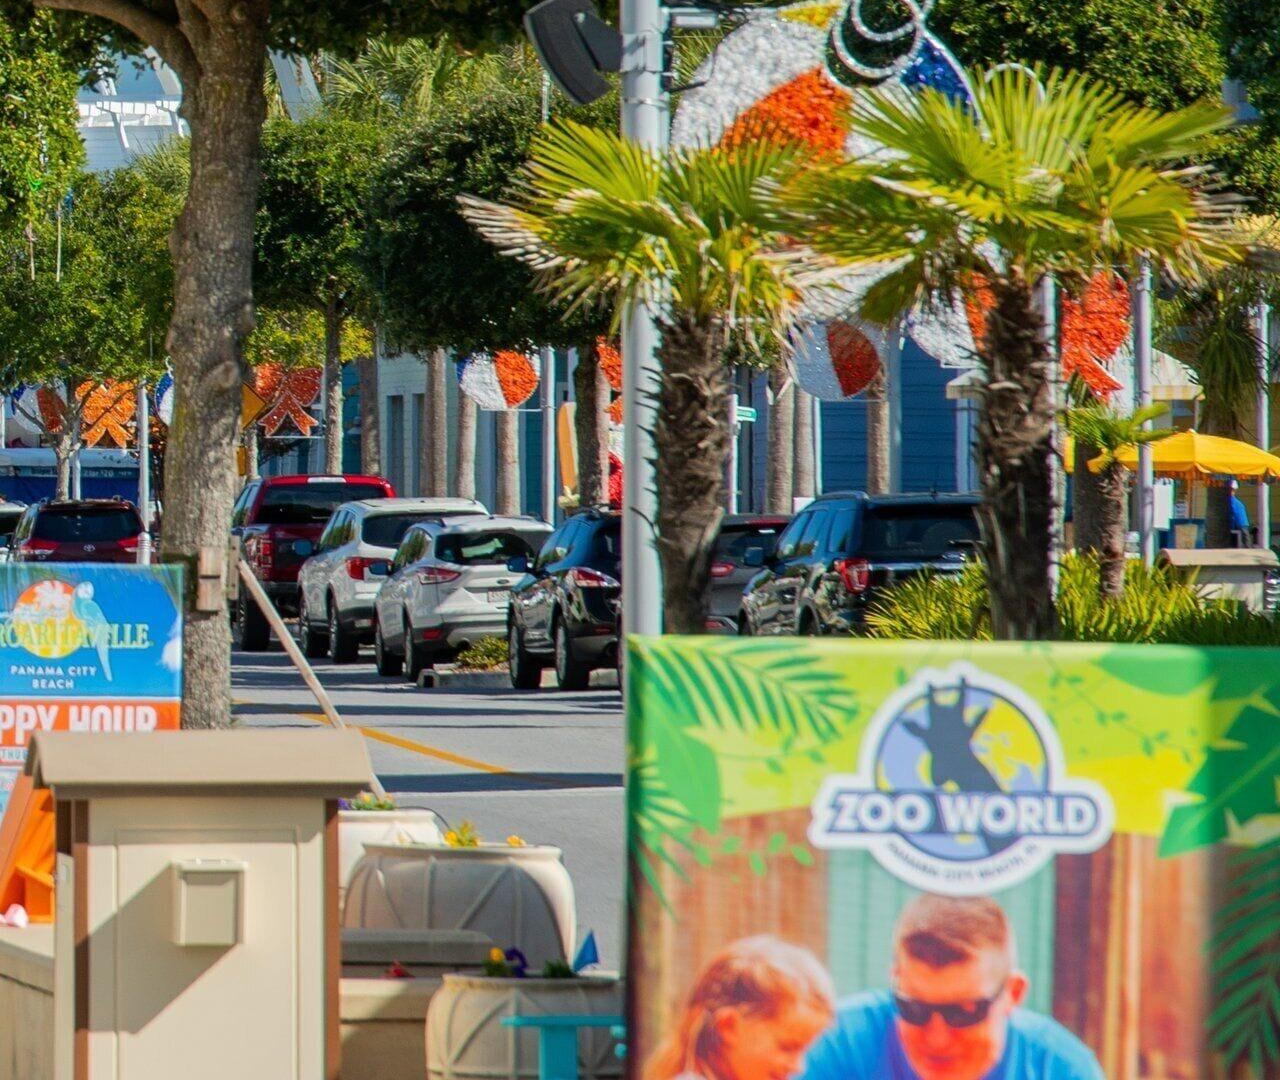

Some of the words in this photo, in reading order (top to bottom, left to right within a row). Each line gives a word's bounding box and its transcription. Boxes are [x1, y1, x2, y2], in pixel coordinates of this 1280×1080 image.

[11, 665, 64, 676] PANAMA
[68, 665, 97, 677] CITY
[32, 678, 75, 689] BEACH
[68, 704, 158, 732] HOUR
[828, 792, 934, 834] ZOO
[938, 793, 1097, 835] WORLD
